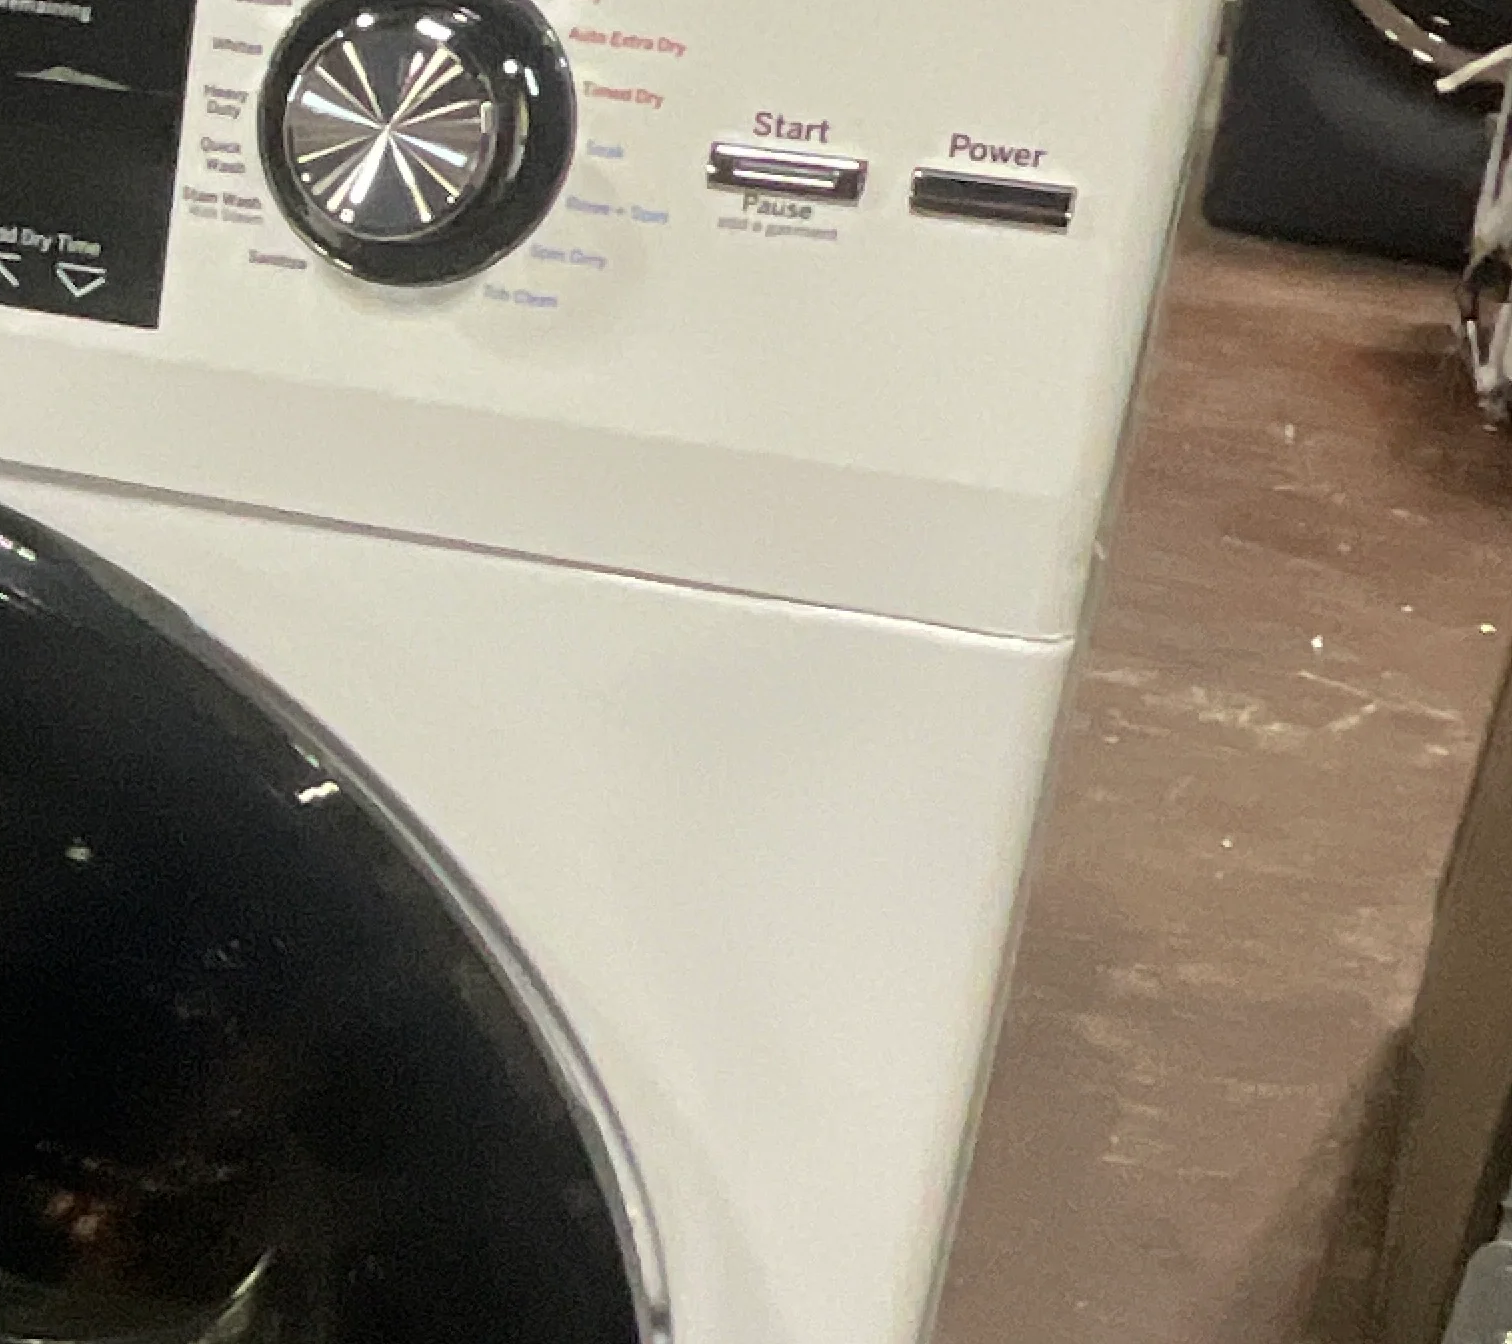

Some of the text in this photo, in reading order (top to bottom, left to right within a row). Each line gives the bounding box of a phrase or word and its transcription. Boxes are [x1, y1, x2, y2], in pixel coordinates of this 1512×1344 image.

[657, 37, 686, 57] Dry
[635, 88, 665, 110] Dry
[753, 111, 830, 143] Start
[949, 132, 1047, 168] Power
[741, 189, 813, 221] Pause
[21, 228, 53, 252] Dry
